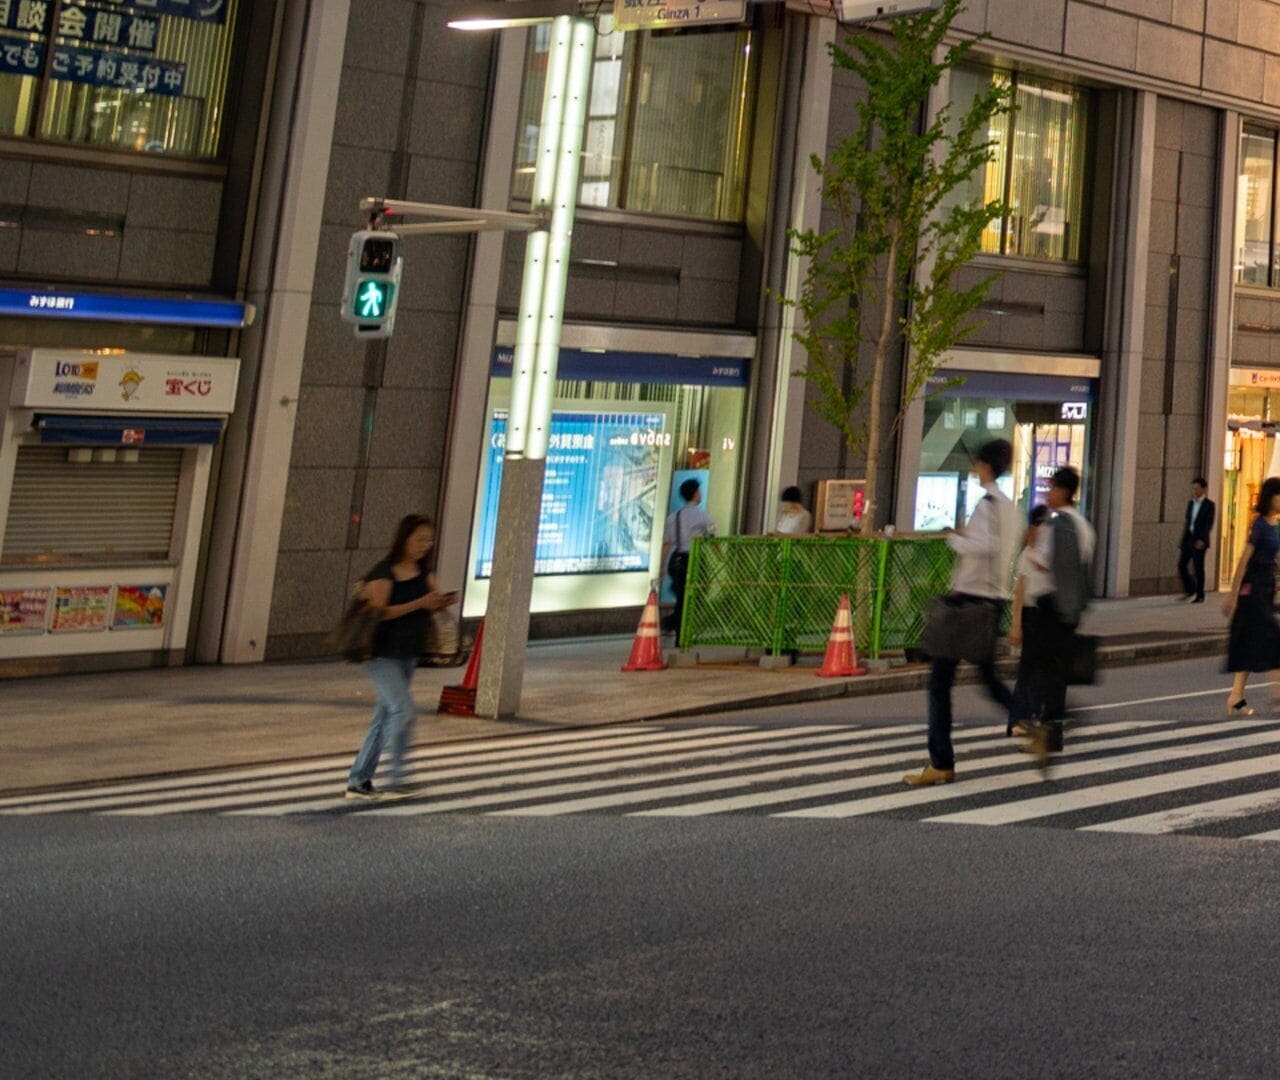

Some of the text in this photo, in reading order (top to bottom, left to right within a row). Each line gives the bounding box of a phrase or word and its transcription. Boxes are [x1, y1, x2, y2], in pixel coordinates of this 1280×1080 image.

[657, 5, 701, 20] Ginza 1
[0, 45, 182, 89] でもご予約受付中
[165, 379, 212, 396] 宝くじ
